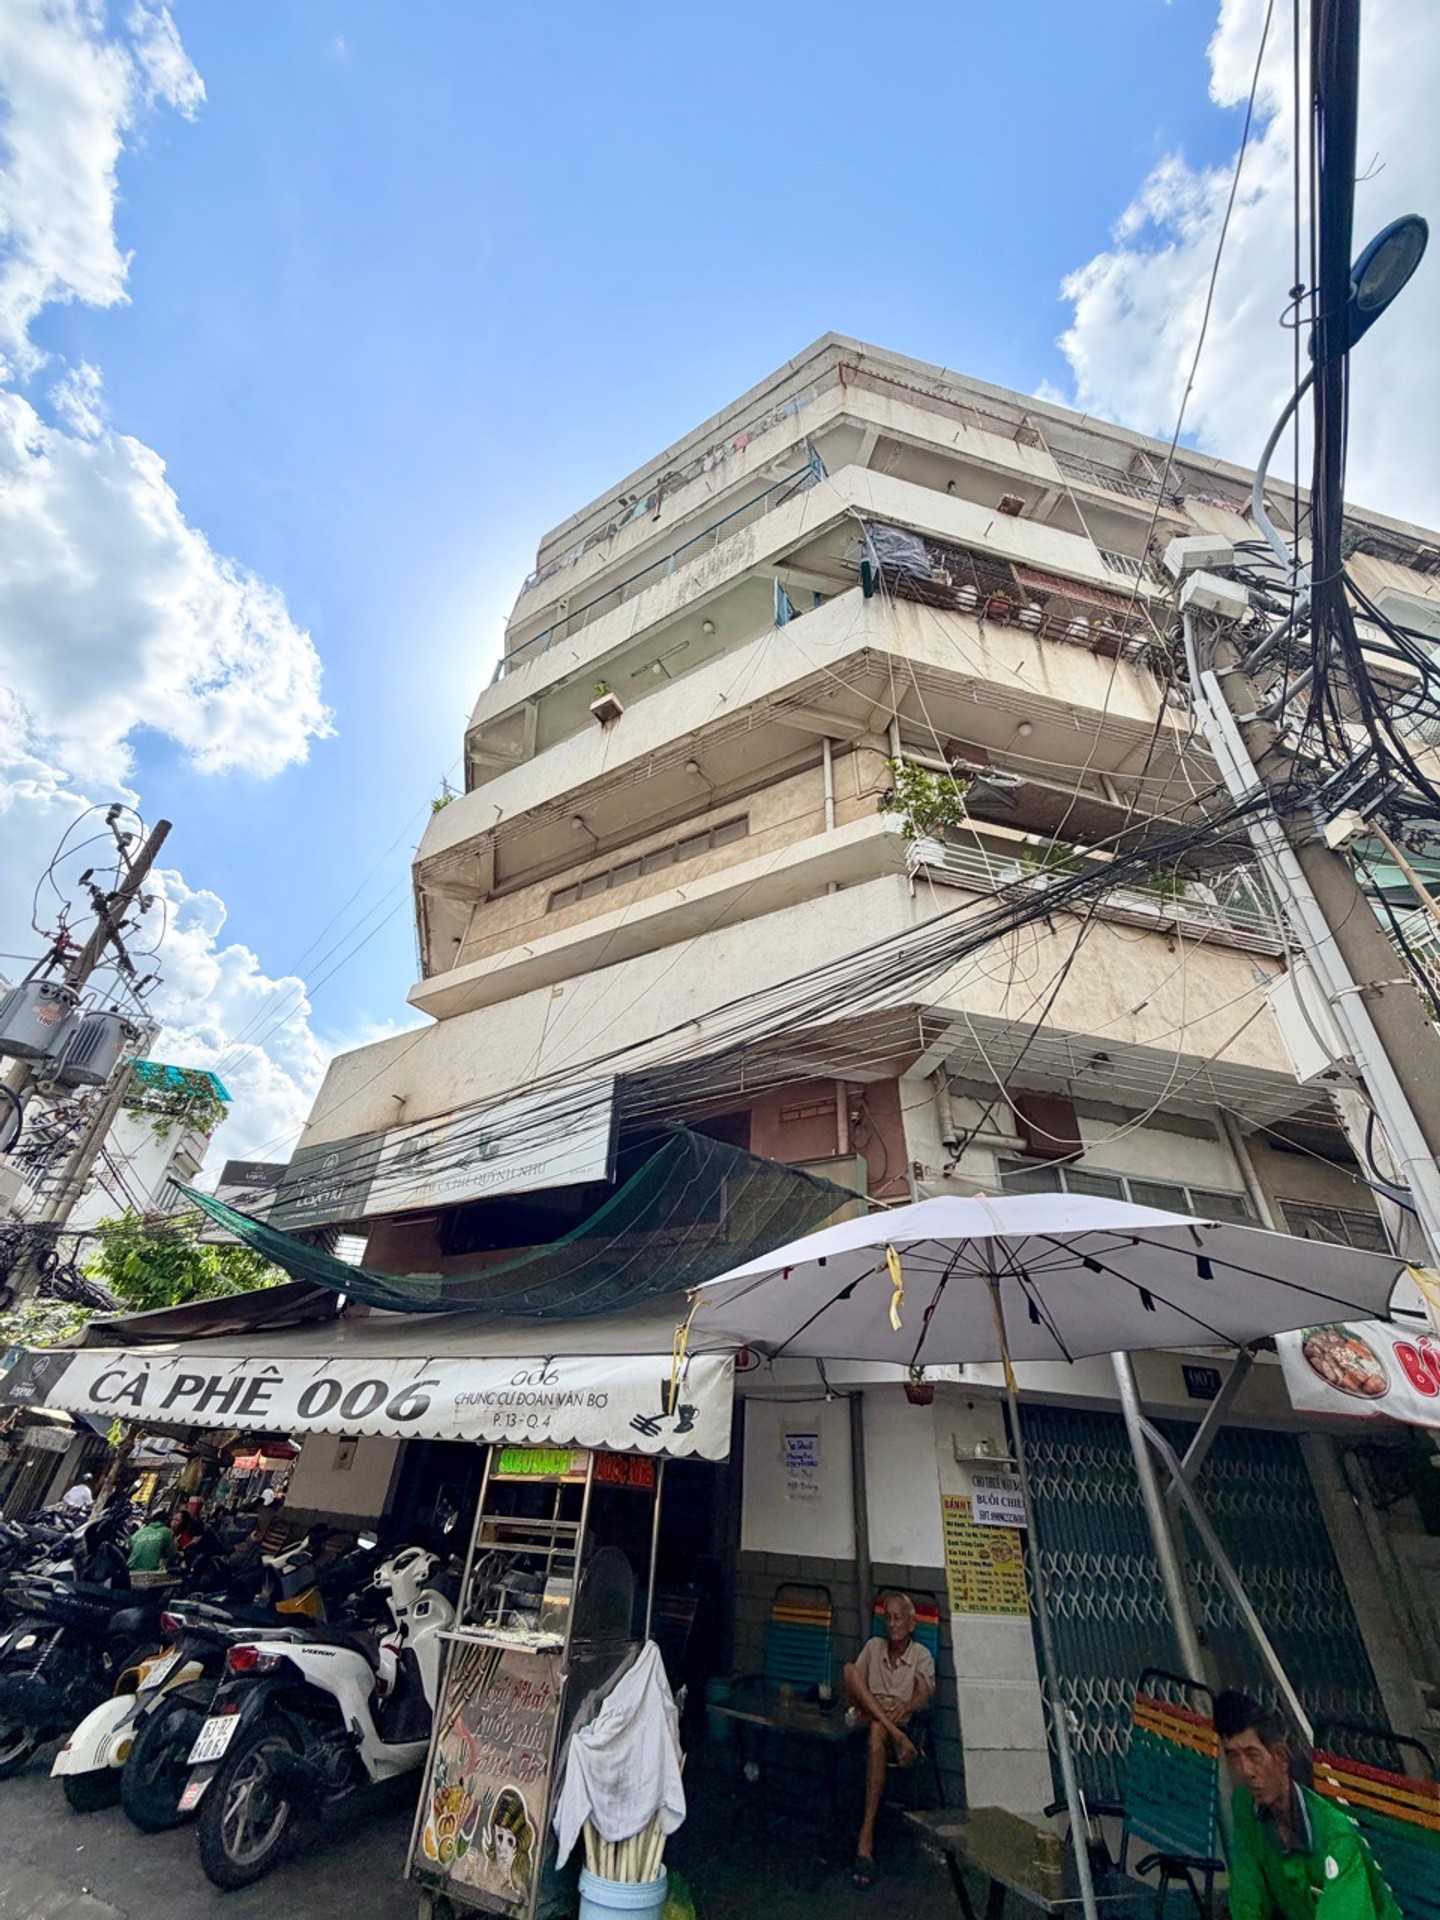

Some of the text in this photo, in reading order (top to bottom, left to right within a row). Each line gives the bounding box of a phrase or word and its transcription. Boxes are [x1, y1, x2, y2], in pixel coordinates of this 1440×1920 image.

[510, 1369, 560, 1386] 006
[88, 1362, 441, 1422] CÀ PHÊ 006
[454, 1391, 495, 1406] CHUNG
[516, 1390, 553, 1406] ĐOÀN
